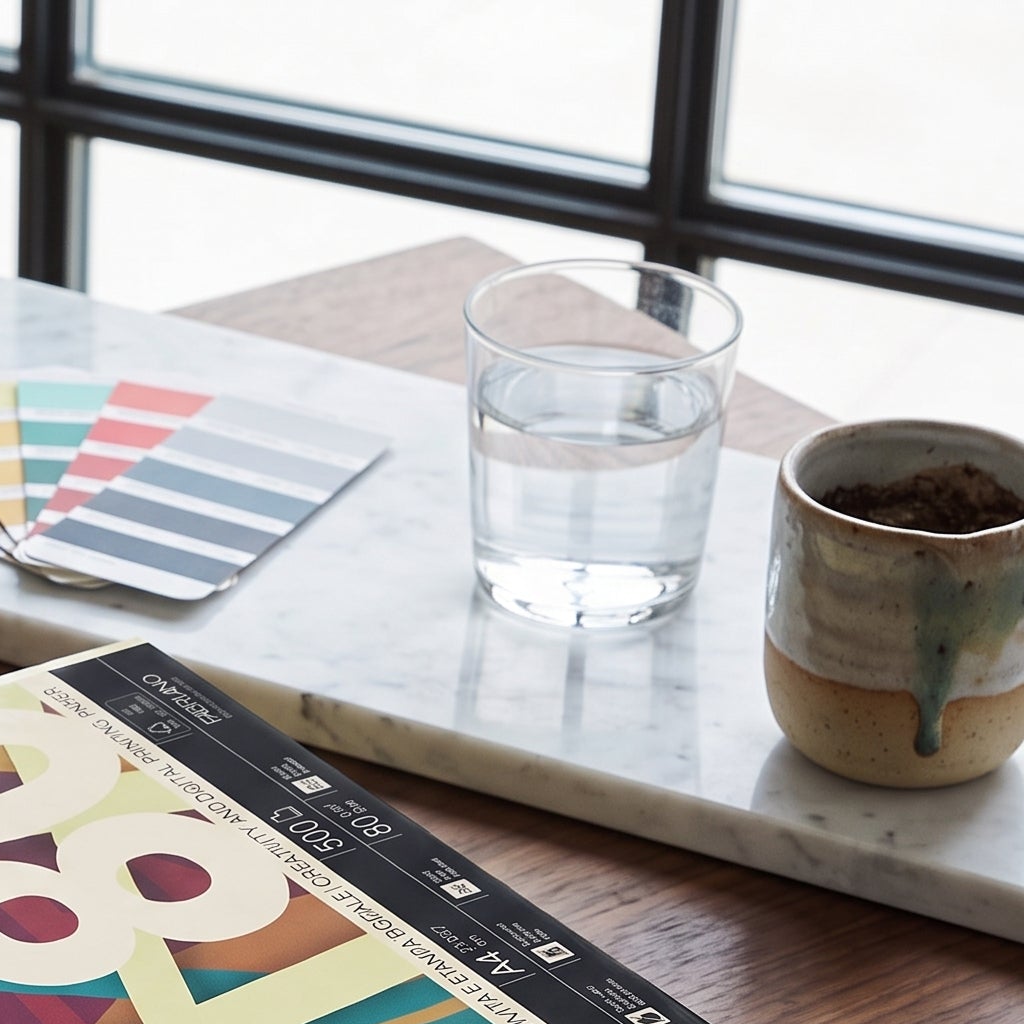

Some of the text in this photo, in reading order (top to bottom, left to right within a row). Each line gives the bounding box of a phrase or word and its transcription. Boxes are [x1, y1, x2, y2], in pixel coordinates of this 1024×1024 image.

[142, 674, 223, 726] FABRIANO
[208, 802, 246, 825] AND
[351, 814, 392, 838] 80
[289, 820, 343, 853] 500
[476, 951, 526, 976] A4
